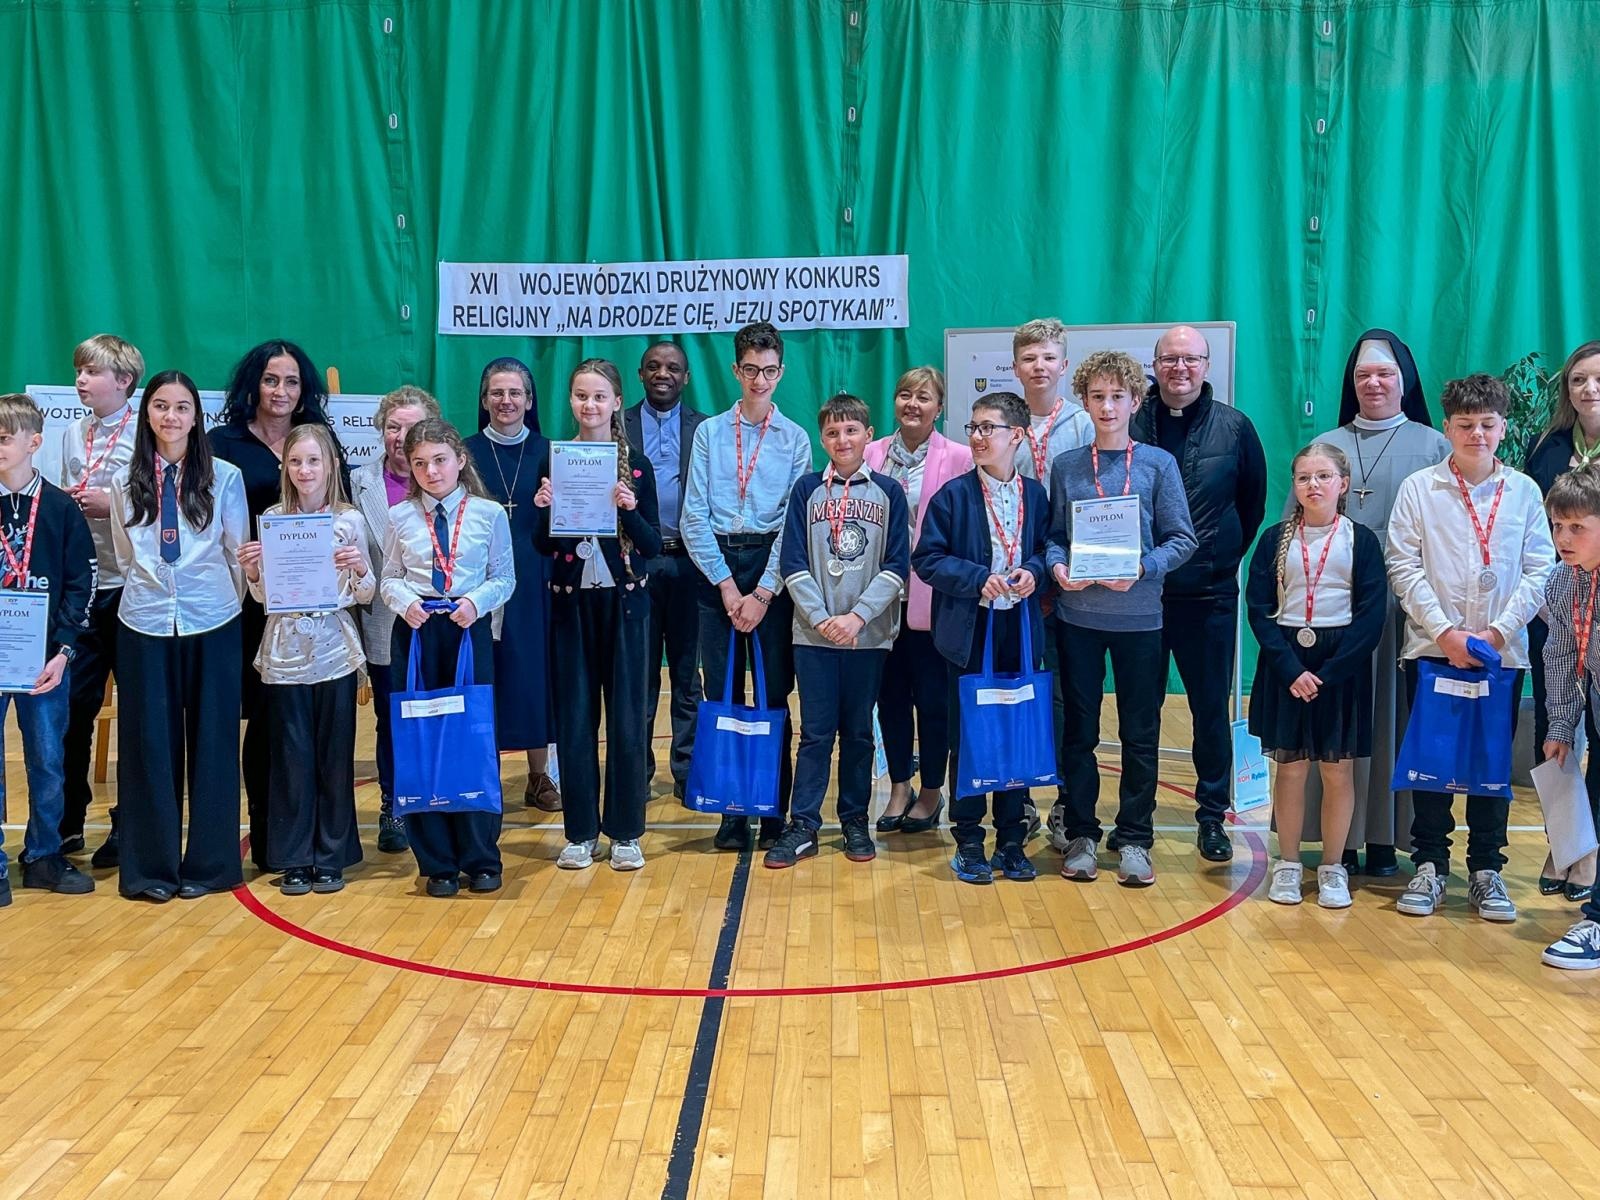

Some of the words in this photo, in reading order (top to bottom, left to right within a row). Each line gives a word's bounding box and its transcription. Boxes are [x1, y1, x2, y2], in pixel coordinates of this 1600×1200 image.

[469, 272, 498, 295] XVI
[519, 267, 650, 295] WOJEWÓDZKI
[657, 264, 780, 294] DRUŻYNOWY
[785, 265, 880, 289] KONKURS
[452, 305, 551, 328] RELIGIJNY
[599, 304, 678, 328] DRODZE
[724, 301, 773, 324] JEZU
[567, 458, 602, 466] DYPLOM
[1089, 512, 1124, 523] DYPLOM
[279, 532, 317, 541] DYPLOM
